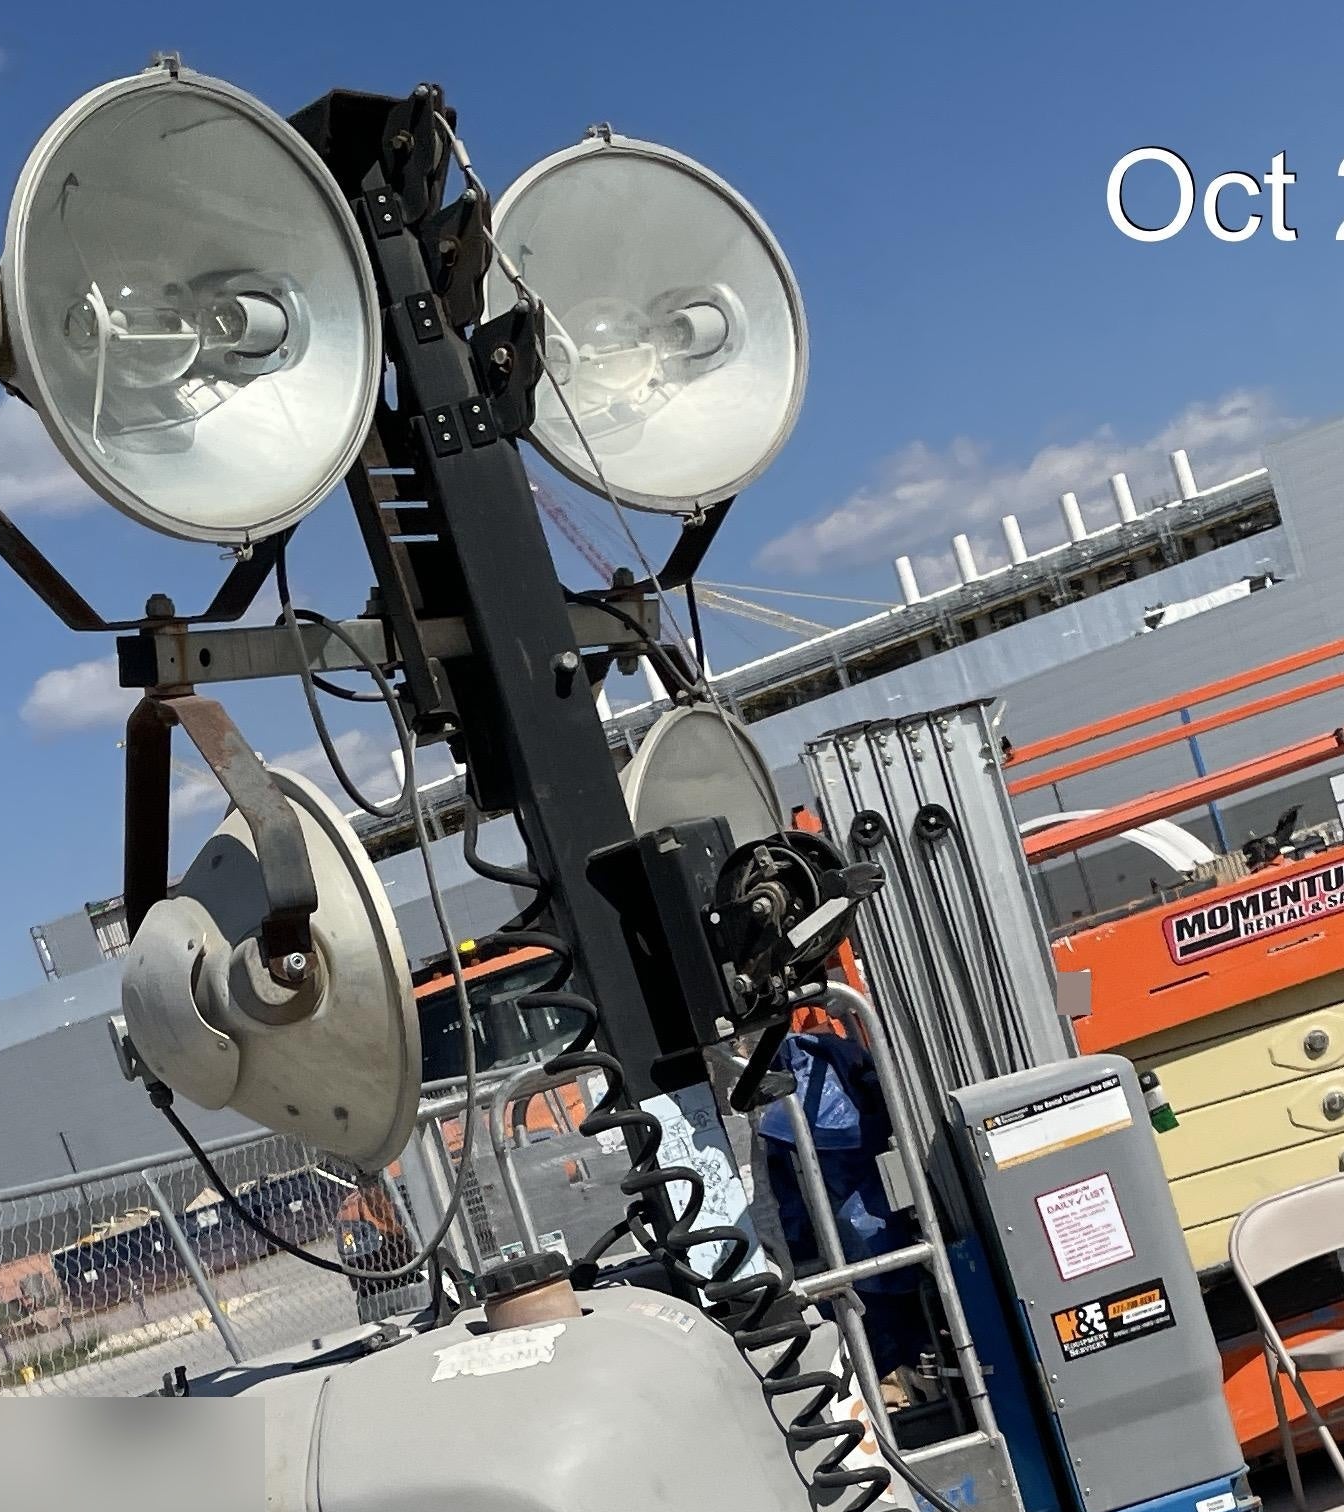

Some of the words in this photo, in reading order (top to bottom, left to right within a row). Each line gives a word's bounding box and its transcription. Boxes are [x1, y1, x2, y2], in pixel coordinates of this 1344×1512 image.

[1244, 906, 1306, 936] RENTAL
[1311, 901, 1323, 914] &
[1047, 1199, 1074, 1214] DAILY
[1085, 1187, 1106, 1201] LIST
